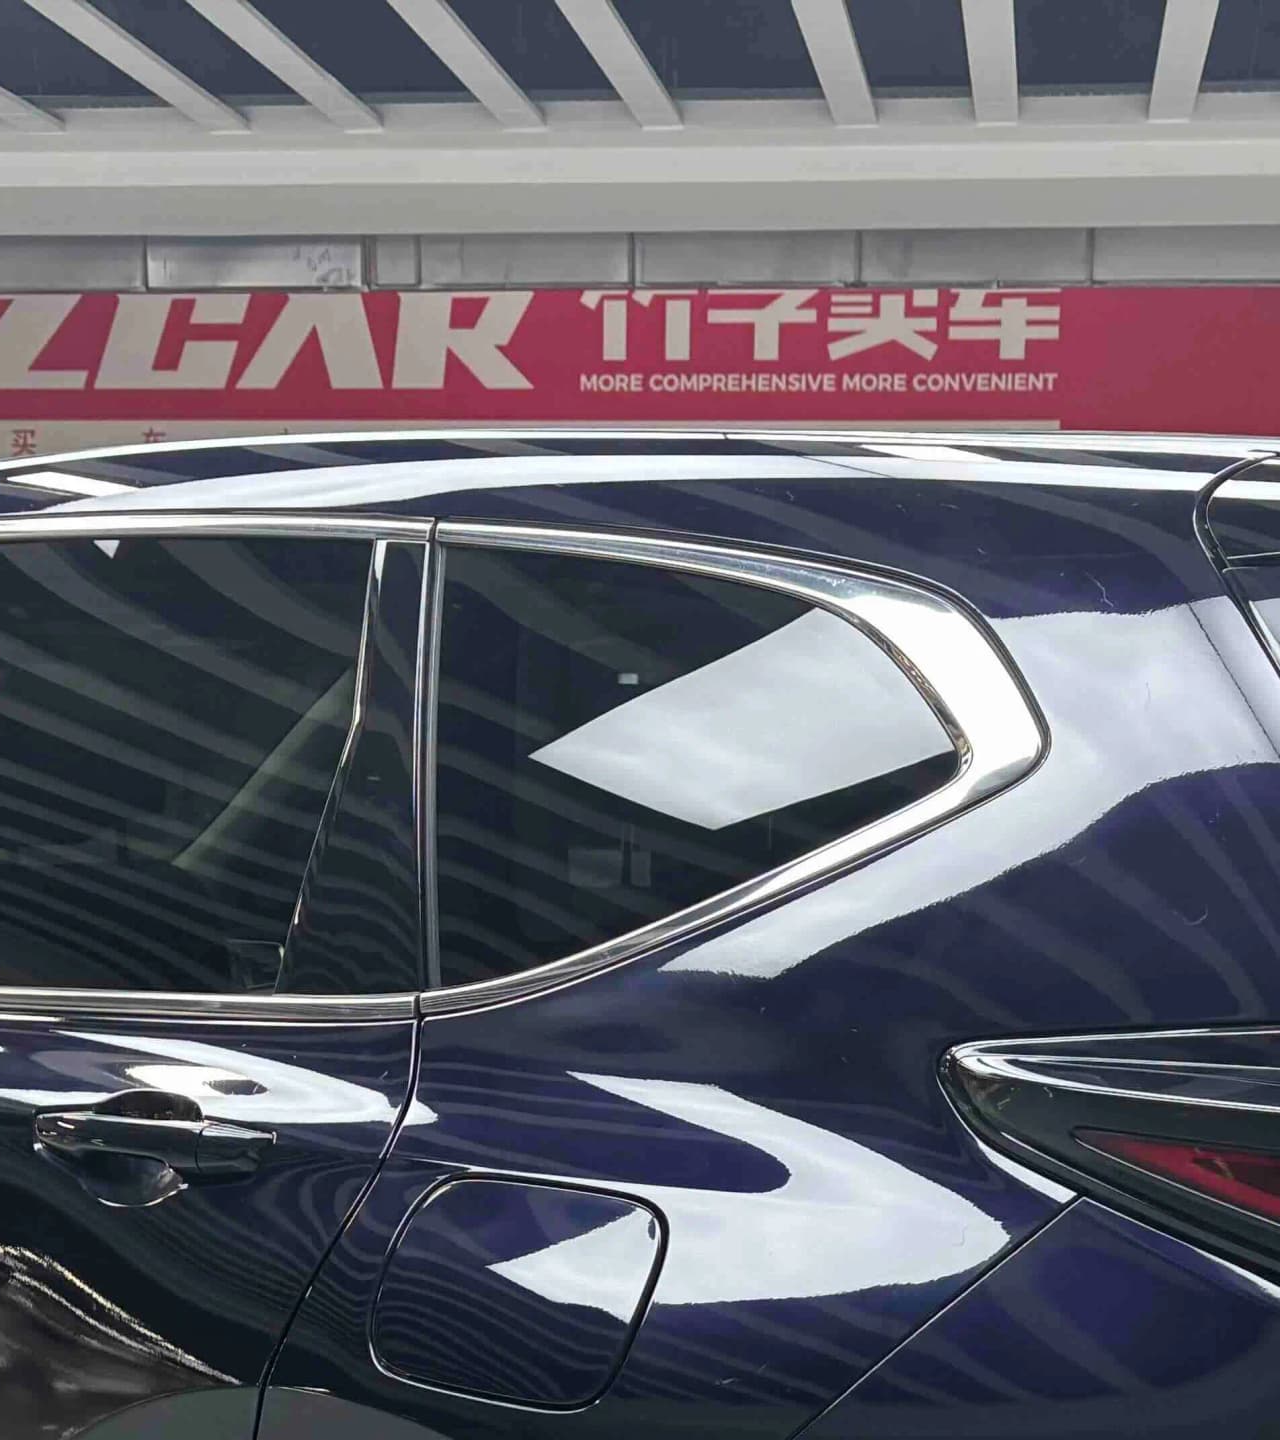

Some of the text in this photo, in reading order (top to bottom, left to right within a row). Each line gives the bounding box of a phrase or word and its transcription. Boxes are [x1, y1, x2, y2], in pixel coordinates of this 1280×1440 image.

[580, 288, 1061, 361] 竹子买车
[580, 373, 1058, 393] MORE COMPREHENSIVE MORE CONVENIENT
